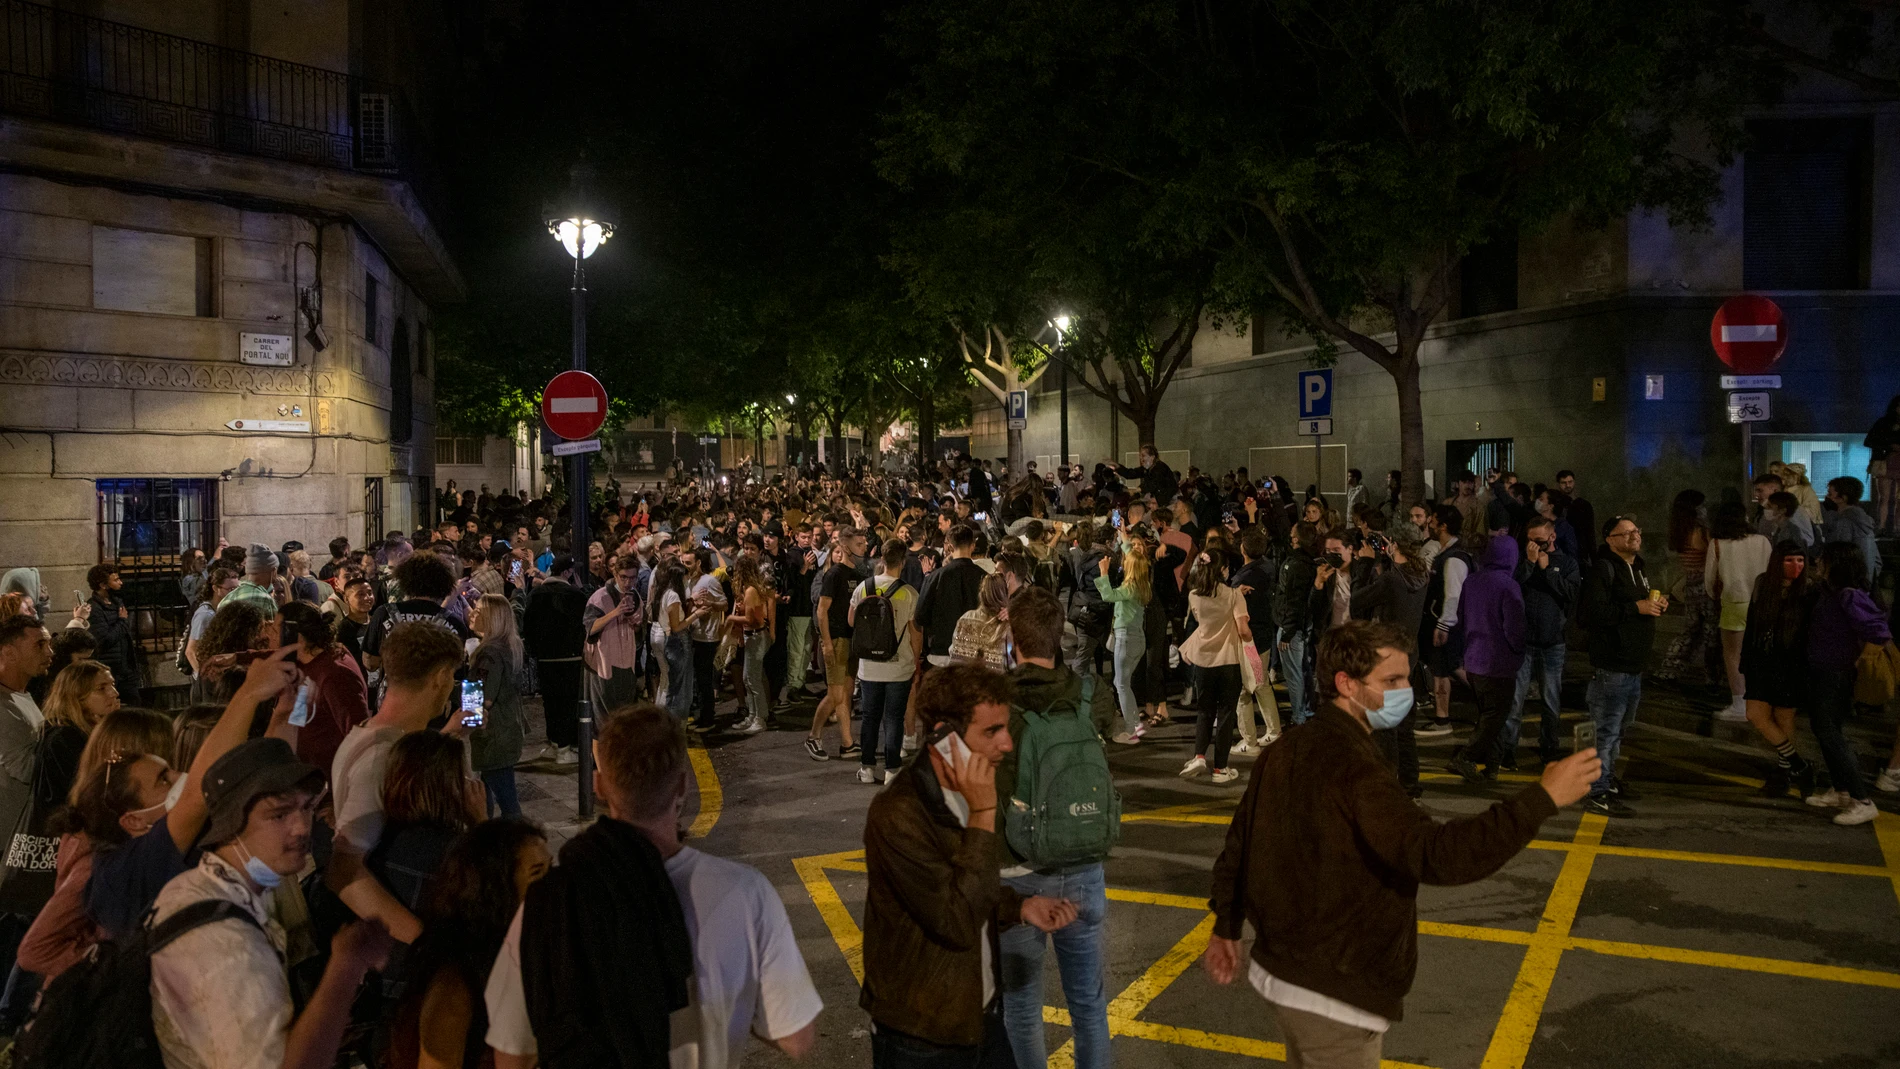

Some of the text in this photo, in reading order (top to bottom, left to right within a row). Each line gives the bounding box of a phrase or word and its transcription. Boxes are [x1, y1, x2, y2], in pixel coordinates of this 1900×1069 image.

[253, 337, 280, 345] CARRER
[243, 350, 289, 360] PORTAL NOU
[1305, 374, 1326, 413] P
[1012, 394, 1022, 416] P
[1081, 802, 1098, 812] SSL
[13, 833, 61, 846] DISCIPLIN
[11, 841, 55, 854] IS NOT A
[8, 849, 58, 861] DIRTY WO
[5, 857, 58, 869] RON DOR
